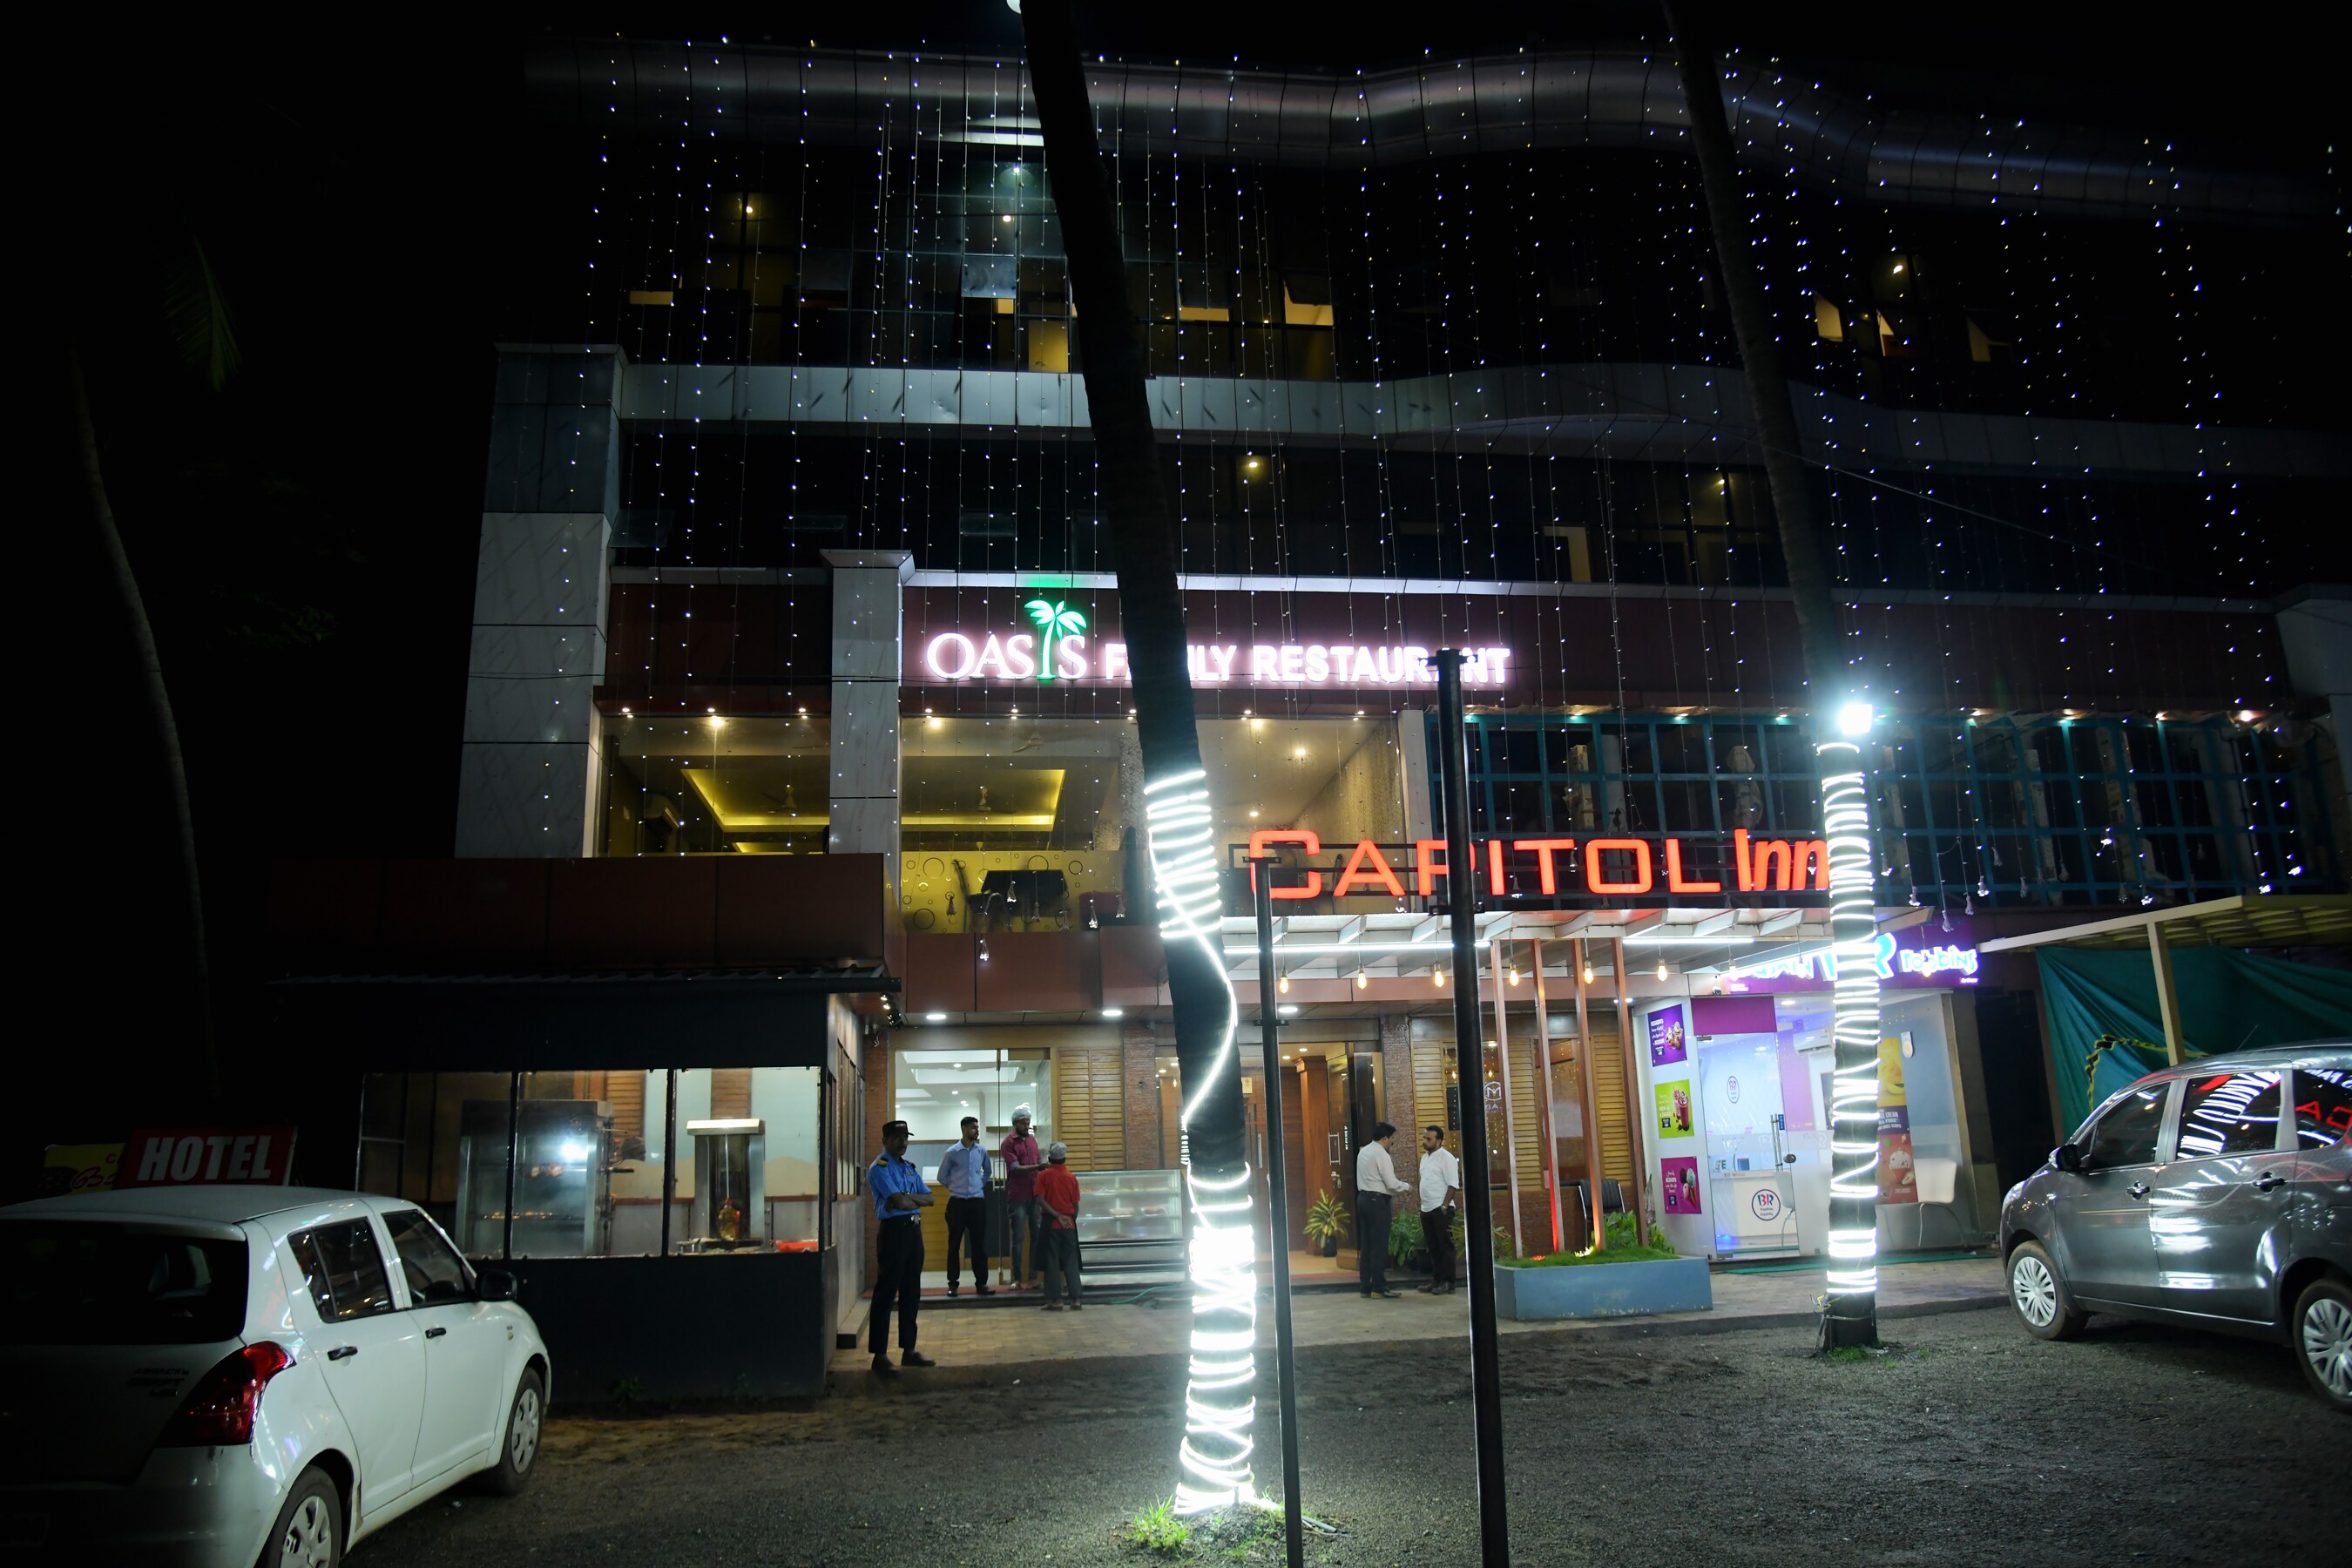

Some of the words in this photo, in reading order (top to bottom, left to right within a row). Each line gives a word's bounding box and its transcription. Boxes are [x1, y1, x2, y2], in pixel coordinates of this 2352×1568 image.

[926, 628, 1087, 680] OASIS
[1253, 645, 1511, 684] RESTAURNT
[1248, 830, 1721, 899] CAPITOL
[1734, 828, 1829, 891] Inn
[136, 1135, 273, 1182] HOTEL
